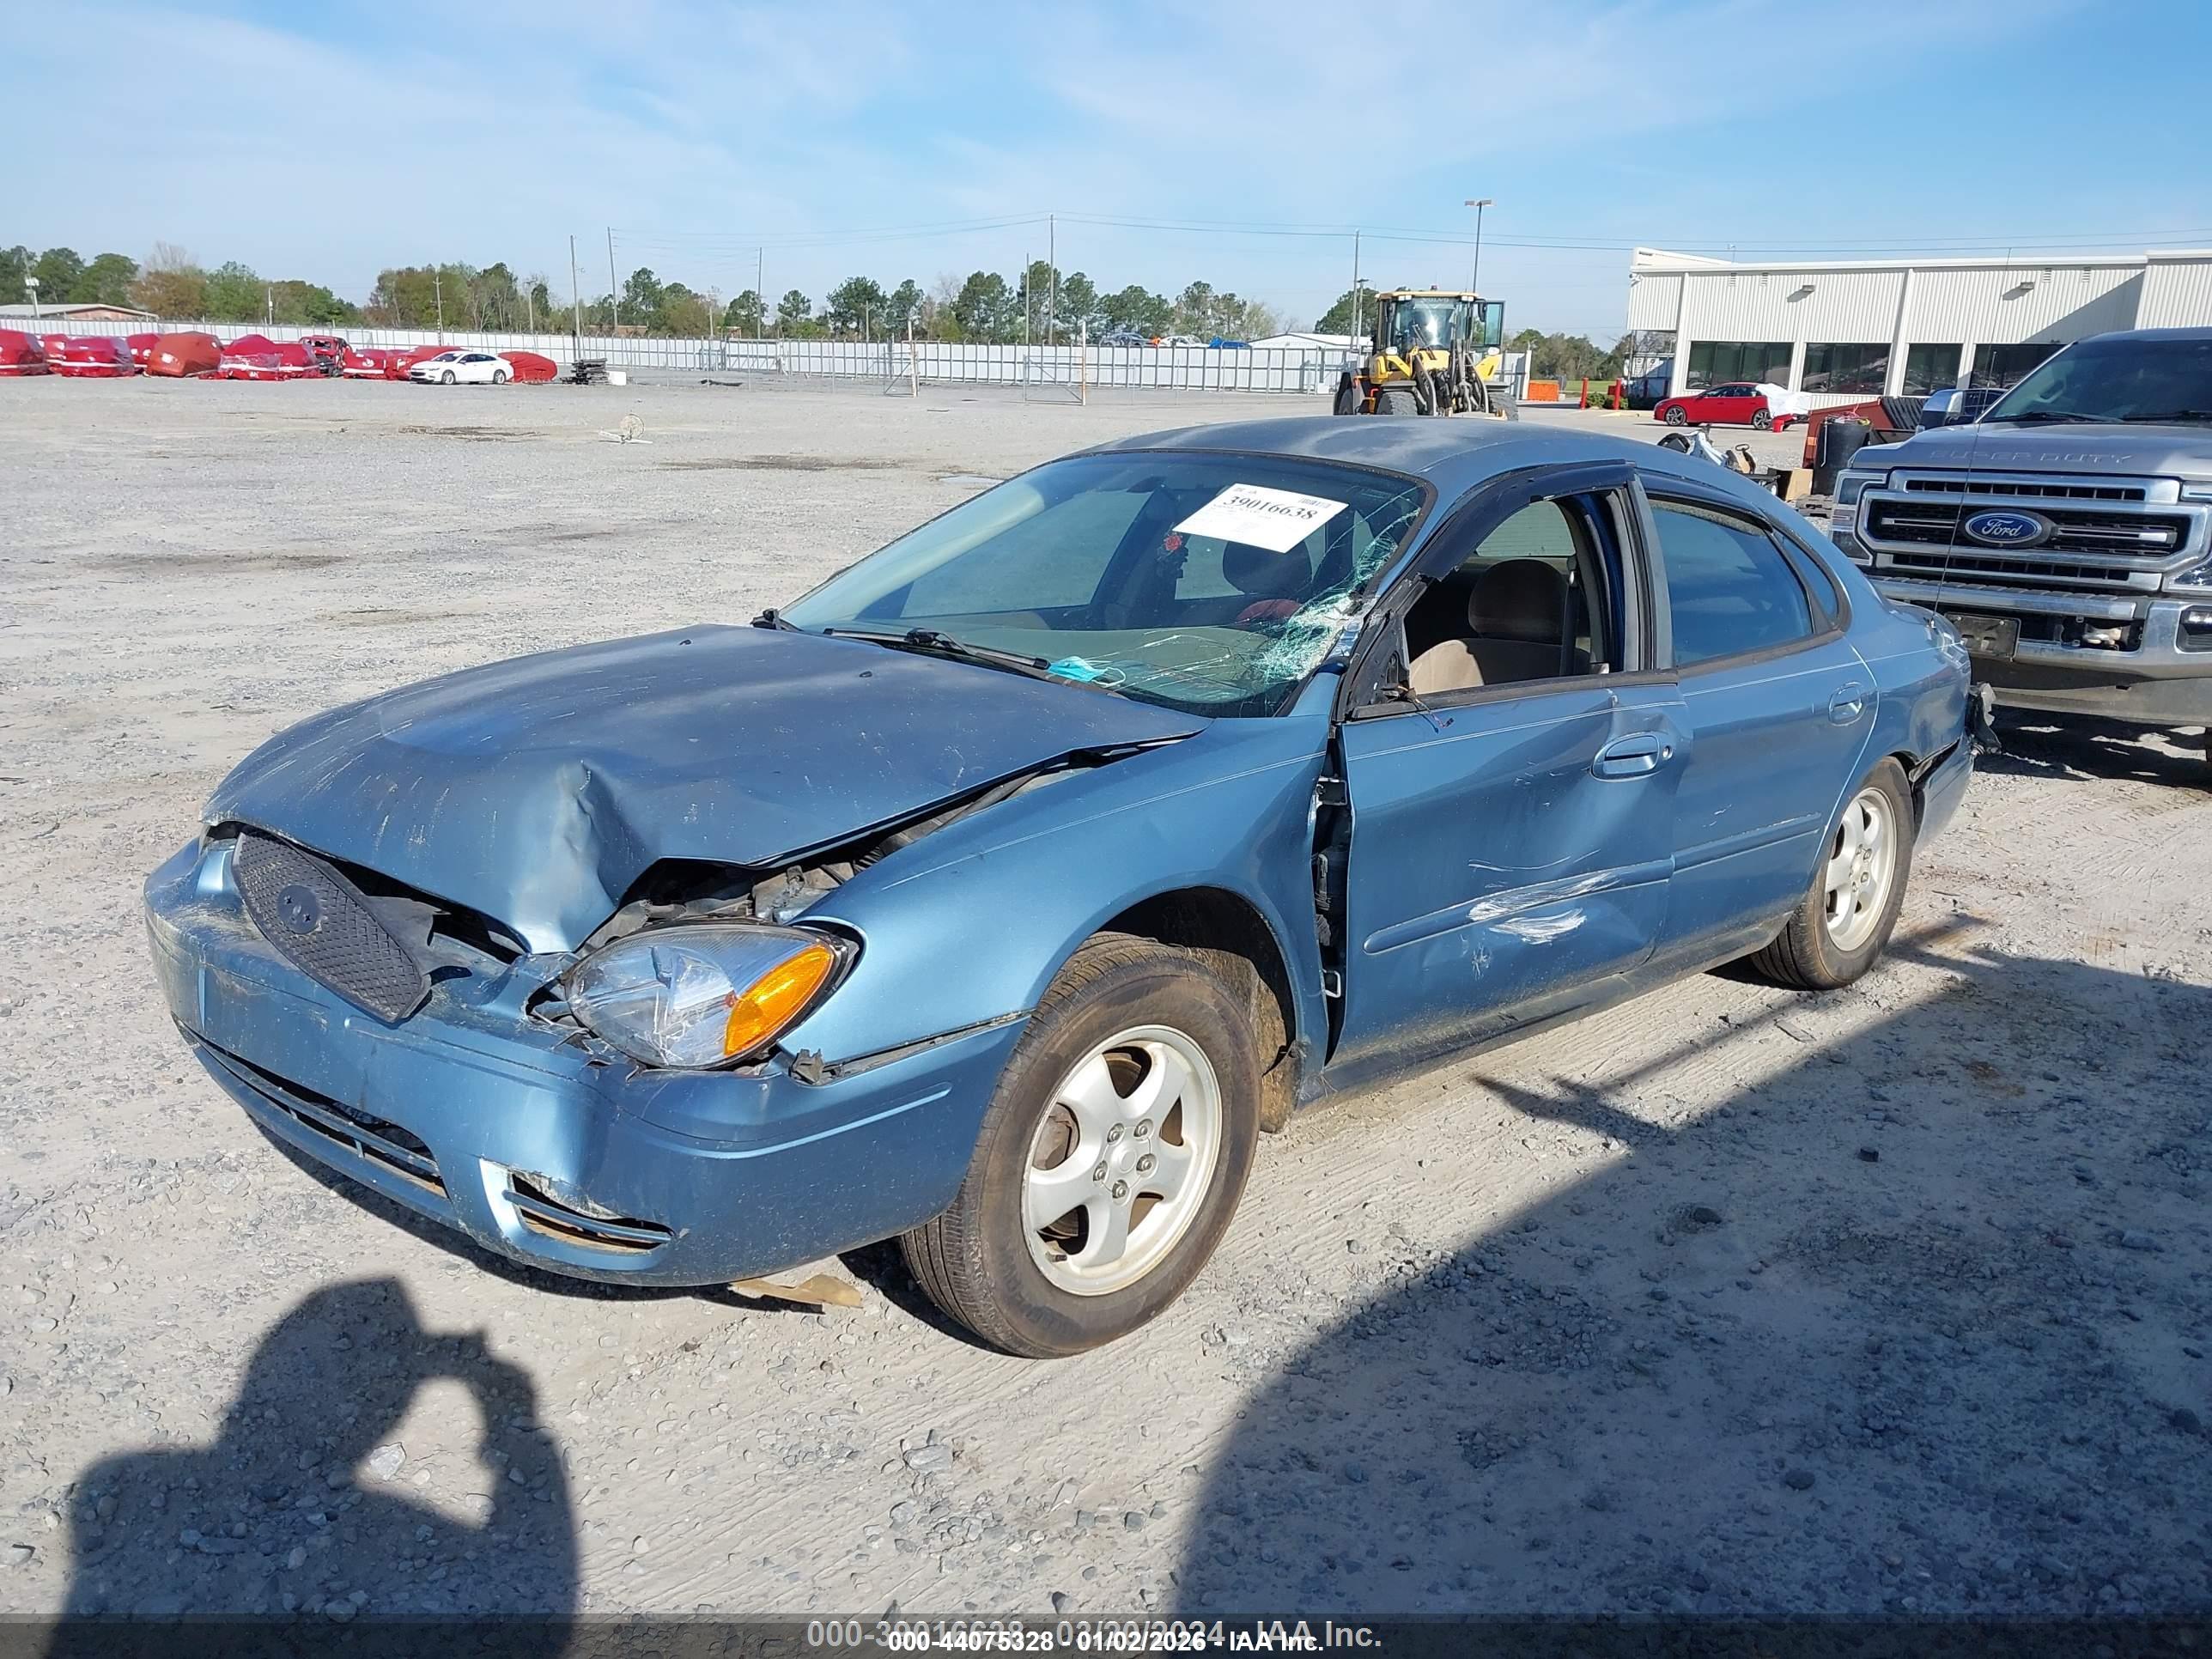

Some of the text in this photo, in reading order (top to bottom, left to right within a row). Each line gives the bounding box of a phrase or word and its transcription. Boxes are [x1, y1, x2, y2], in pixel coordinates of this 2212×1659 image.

[1930, 450, 2133, 465] SUPER DUTY
[1222, 495, 1318, 520] 39016638
[1981, 519, 2021, 538] Ford
